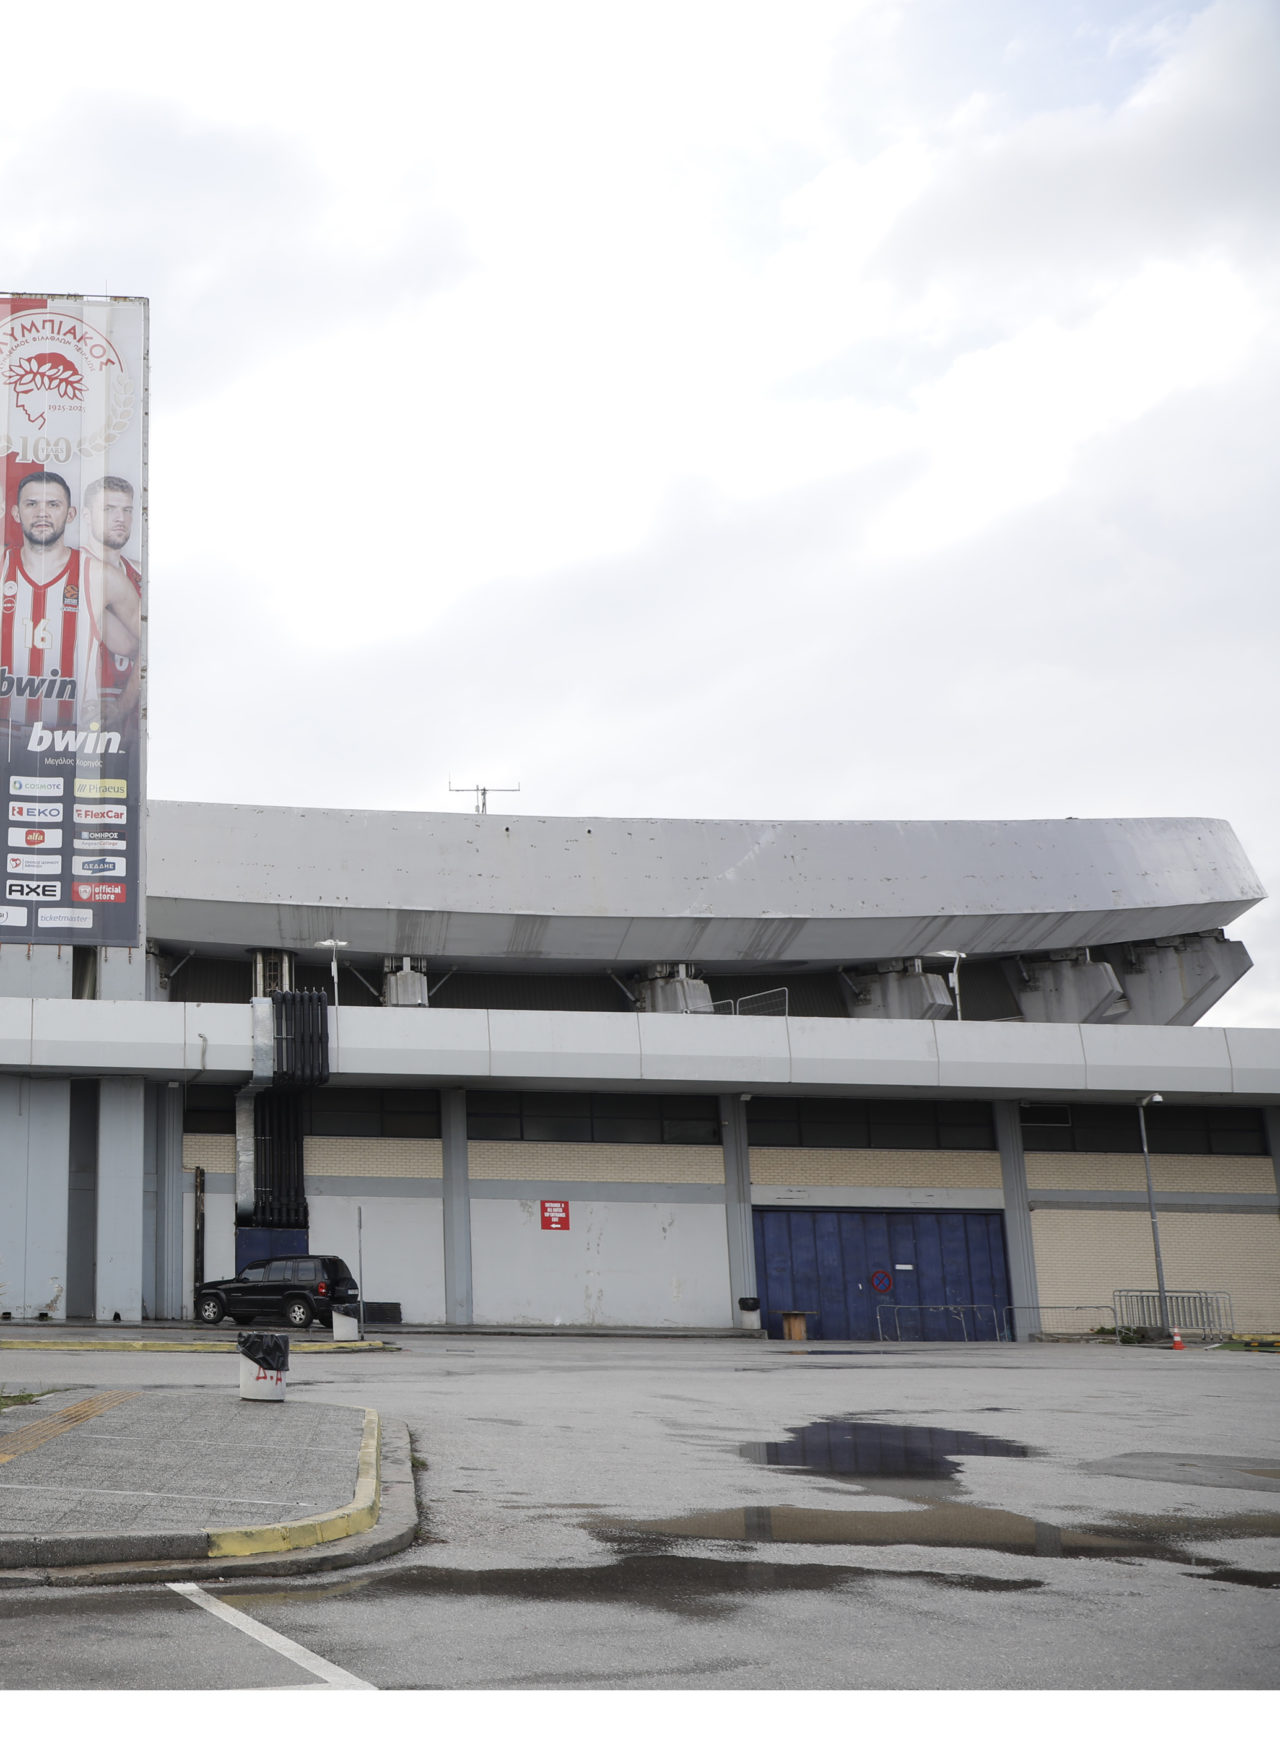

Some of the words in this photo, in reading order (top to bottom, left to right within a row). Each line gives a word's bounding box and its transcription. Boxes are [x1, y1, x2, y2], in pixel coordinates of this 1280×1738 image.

[48, 404, 86, 413] 1925-2025
[17, 437, 71, 463] 100
[22, 616, 53, 649] 16
[44, 757, 74, 767] Μεγάλος
[89, 784, 125, 793] Piraeus
[26, 808, 60, 817] EKO
[84, 810, 124, 819] FlexCar
[27, 832, 43, 841] alfa
[8, 884, 57, 896] AXE
[94, 884, 121, 893] official
[40, 914, 88, 922] ticketmaster
